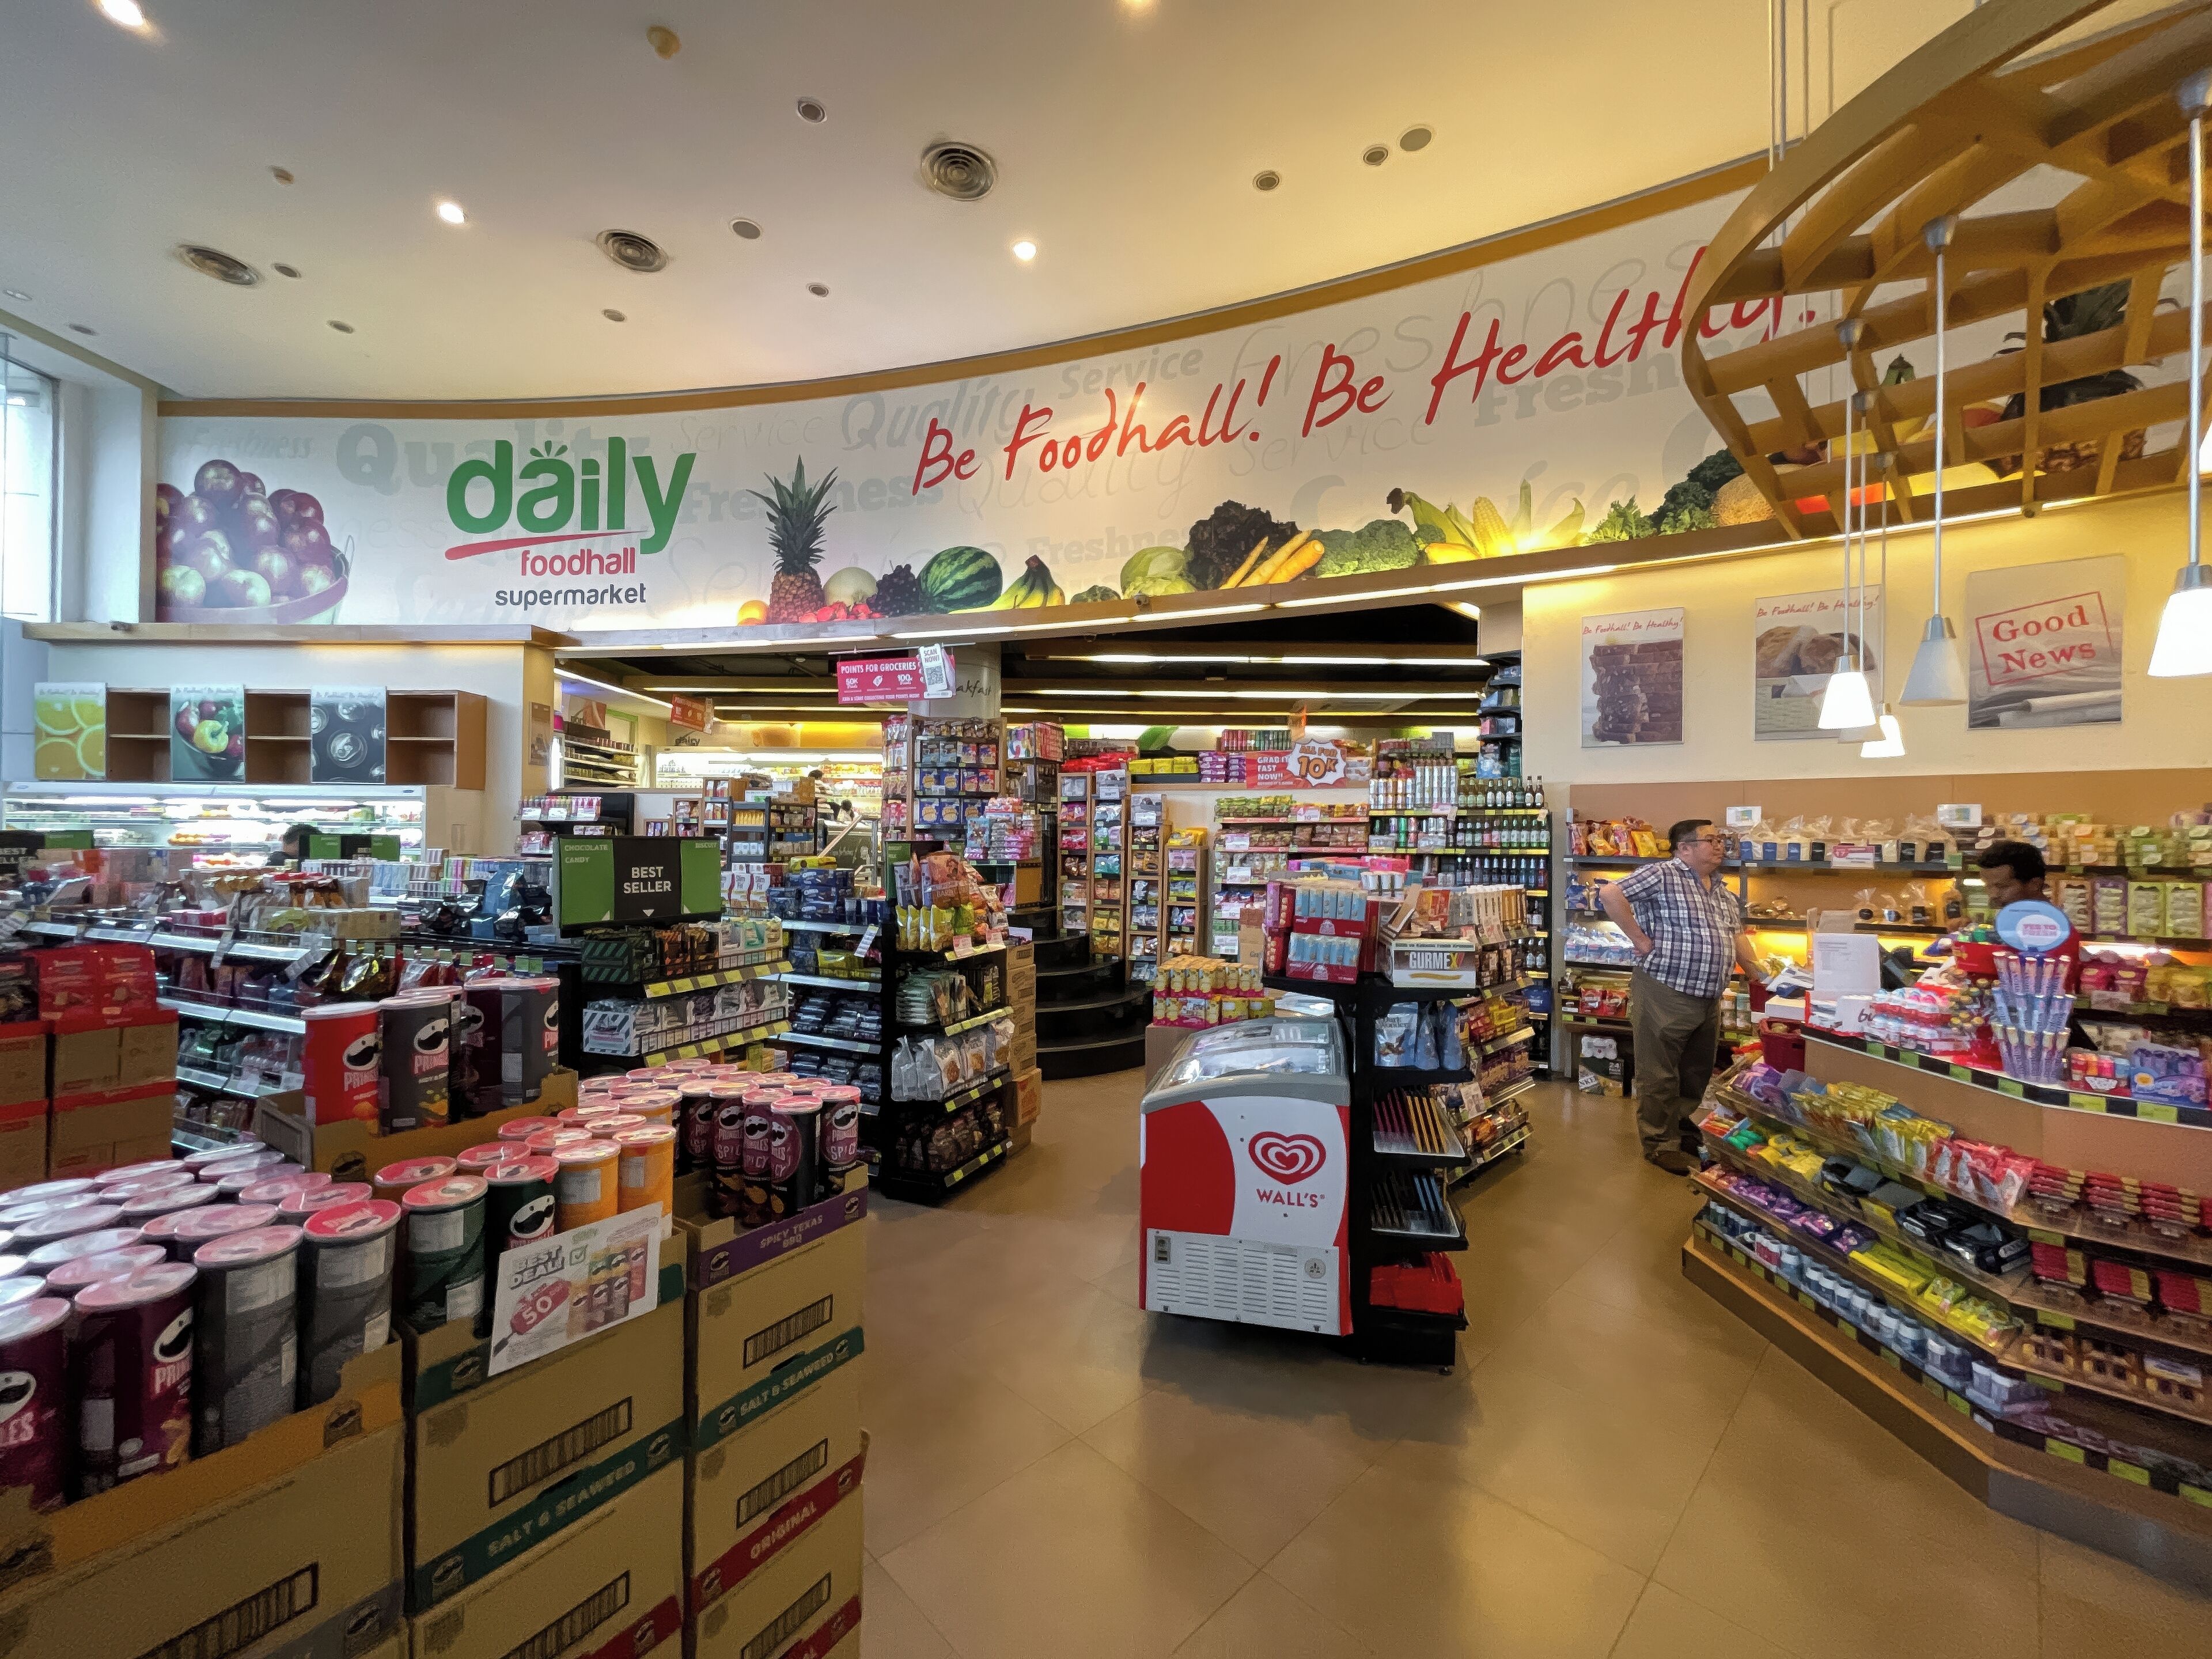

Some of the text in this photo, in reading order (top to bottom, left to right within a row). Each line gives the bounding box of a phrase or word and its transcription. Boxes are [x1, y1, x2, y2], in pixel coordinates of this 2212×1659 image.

[1058, 347, 1204, 400] Service
[912, 418, 983, 496] Be
[1003, 354, 1281, 481] Foodhall!
[1302, 343, 1395, 438] Be
[446, 436, 697, 555] daily
[521, 547, 635, 576] foodhall
[495, 582, 646, 611] supermarket
[1756, 608, 1767, 618] Be
[1772, 602, 1815, 616] Foodhall!
[1817, 601, 1830, 612] Be
[1582, 616, 1683, 635] Be Foodhall! Be Healthy!
[1993, 605, 2090, 642] Good
[923, 647, 938, 657] SCAN
[1997, 641, 2097, 674] News
[840, 661, 916, 674] POINTS FOR GROCERIES
[1300, 745, 1317, 755] ALL
[1297, 755, 1339, 779] 10K
[565, 844, 608, 852] CHOCOLATE
[631, 866, 664, 878] BEST
[623, 881, 672, 894] SELLER
[1409, 952, 1459, 971] GURMEX
[1256, 1188, 1319, 1208] WALL'S
[760, 1214, 824, 1249] SPICY TEXAS
[740, 1390, 770, 1416] SALT
[782, 1350, 835, 1392] SEAWEED
[487, 1519, 534, 1558] SALT
[555, 1460, 636, 1517] SEAWEED
[750, 1500, 819, 1560] ORIGINAL
